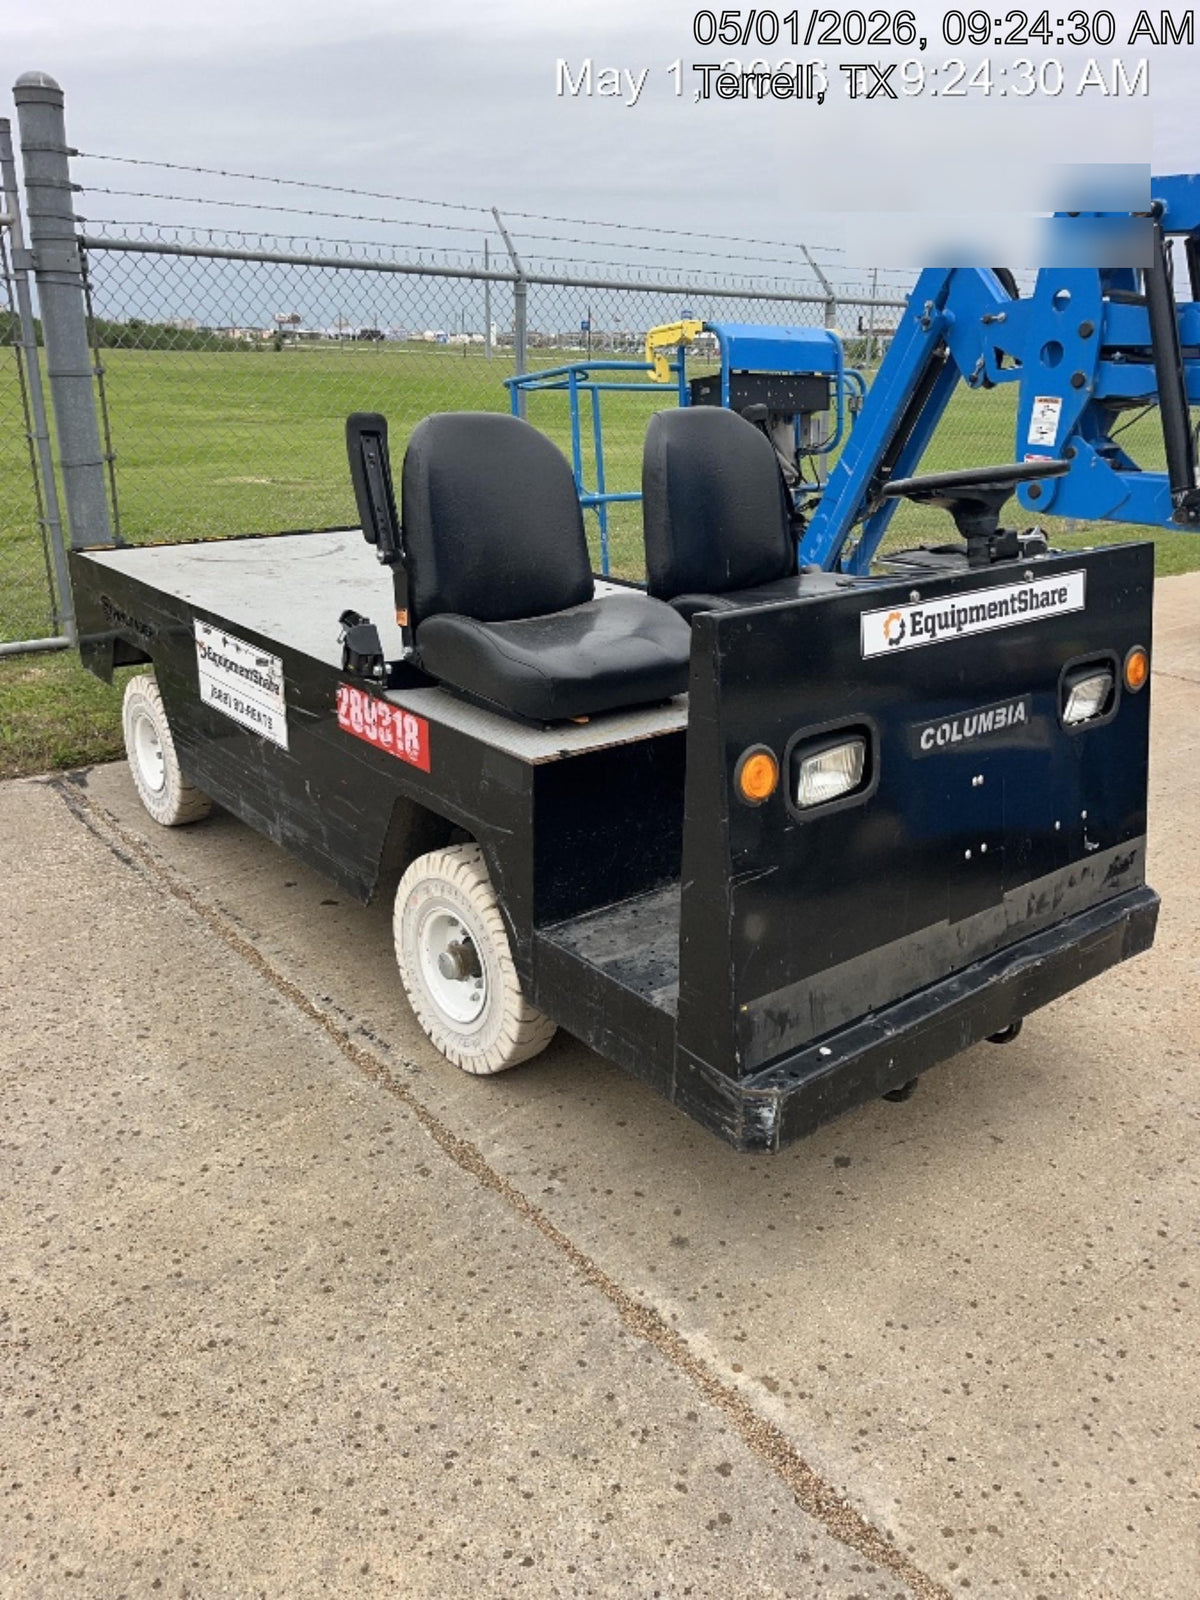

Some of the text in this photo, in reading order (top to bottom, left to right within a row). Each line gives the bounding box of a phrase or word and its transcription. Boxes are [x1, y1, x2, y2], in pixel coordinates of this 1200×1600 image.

[910, 586, 1068, 637] EquipmentShare
[336, 687, 420, 762] 289318
[920, 701, 1026, 750] COLUMBIA
